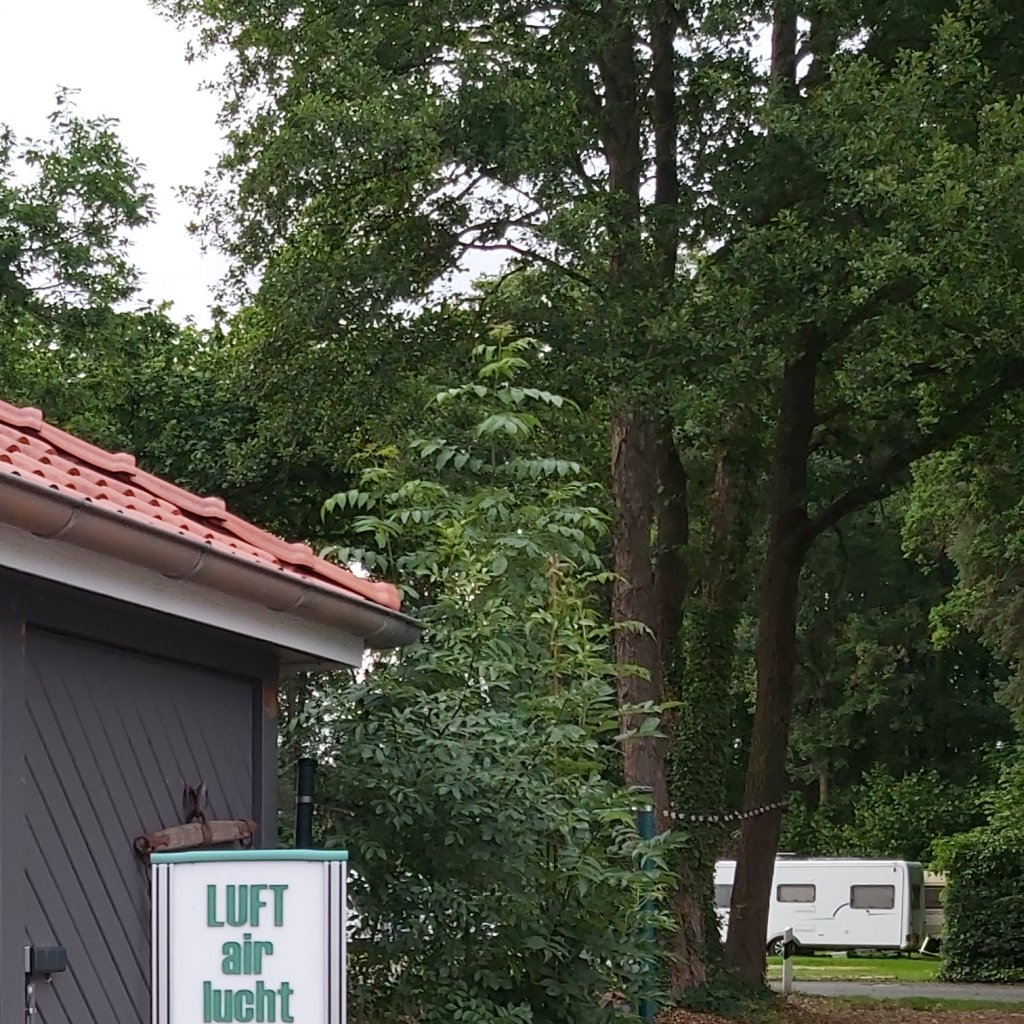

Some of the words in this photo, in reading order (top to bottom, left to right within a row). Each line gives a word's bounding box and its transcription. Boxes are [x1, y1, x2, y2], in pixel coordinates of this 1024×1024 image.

[207, 884, 289, 927] LUFT
[221, 933, 274, 975] air
[203, 980, 294, 1023] lucht
